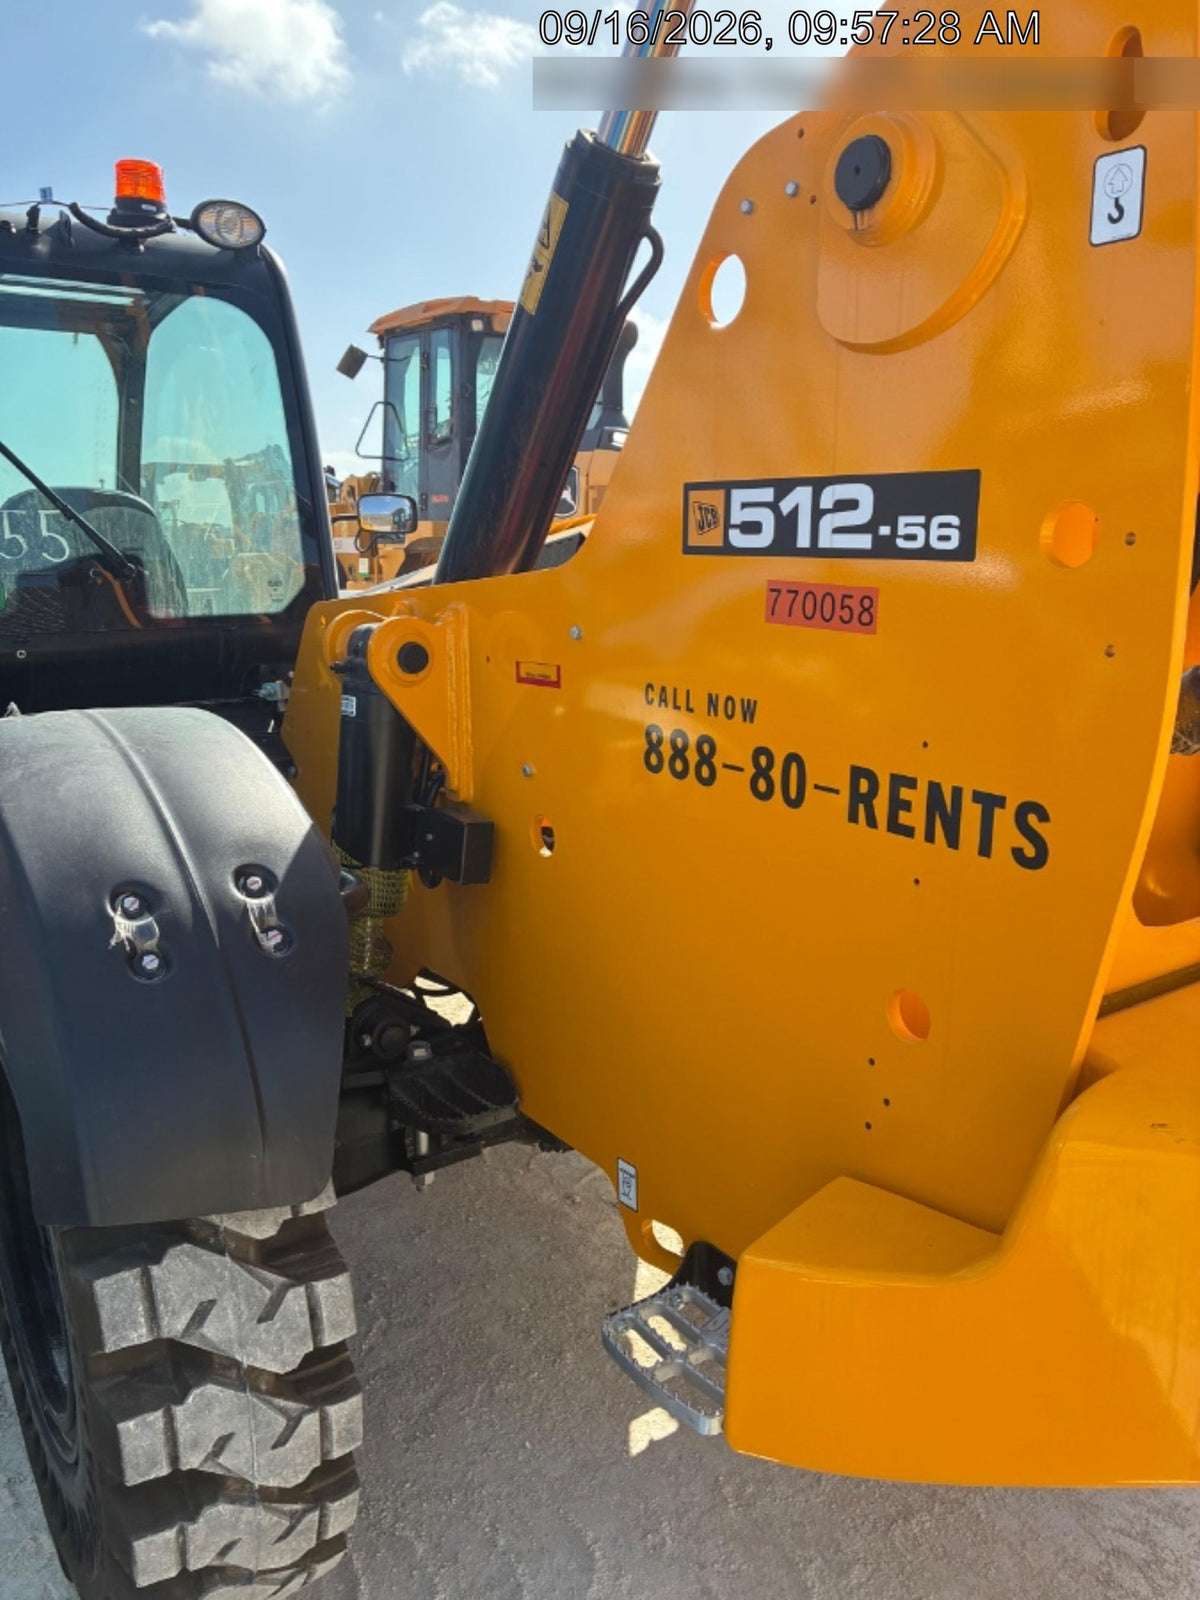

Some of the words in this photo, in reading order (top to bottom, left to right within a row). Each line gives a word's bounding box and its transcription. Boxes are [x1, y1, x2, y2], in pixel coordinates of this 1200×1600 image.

[695, 503, 719, 533] JCB
[769, 588, 874, 626] 770058
[645, 682, 695, 713] CALL
[707, 692, 758, 724] NOW
[643, 723, 1051, 871] 888-80-RENTS
